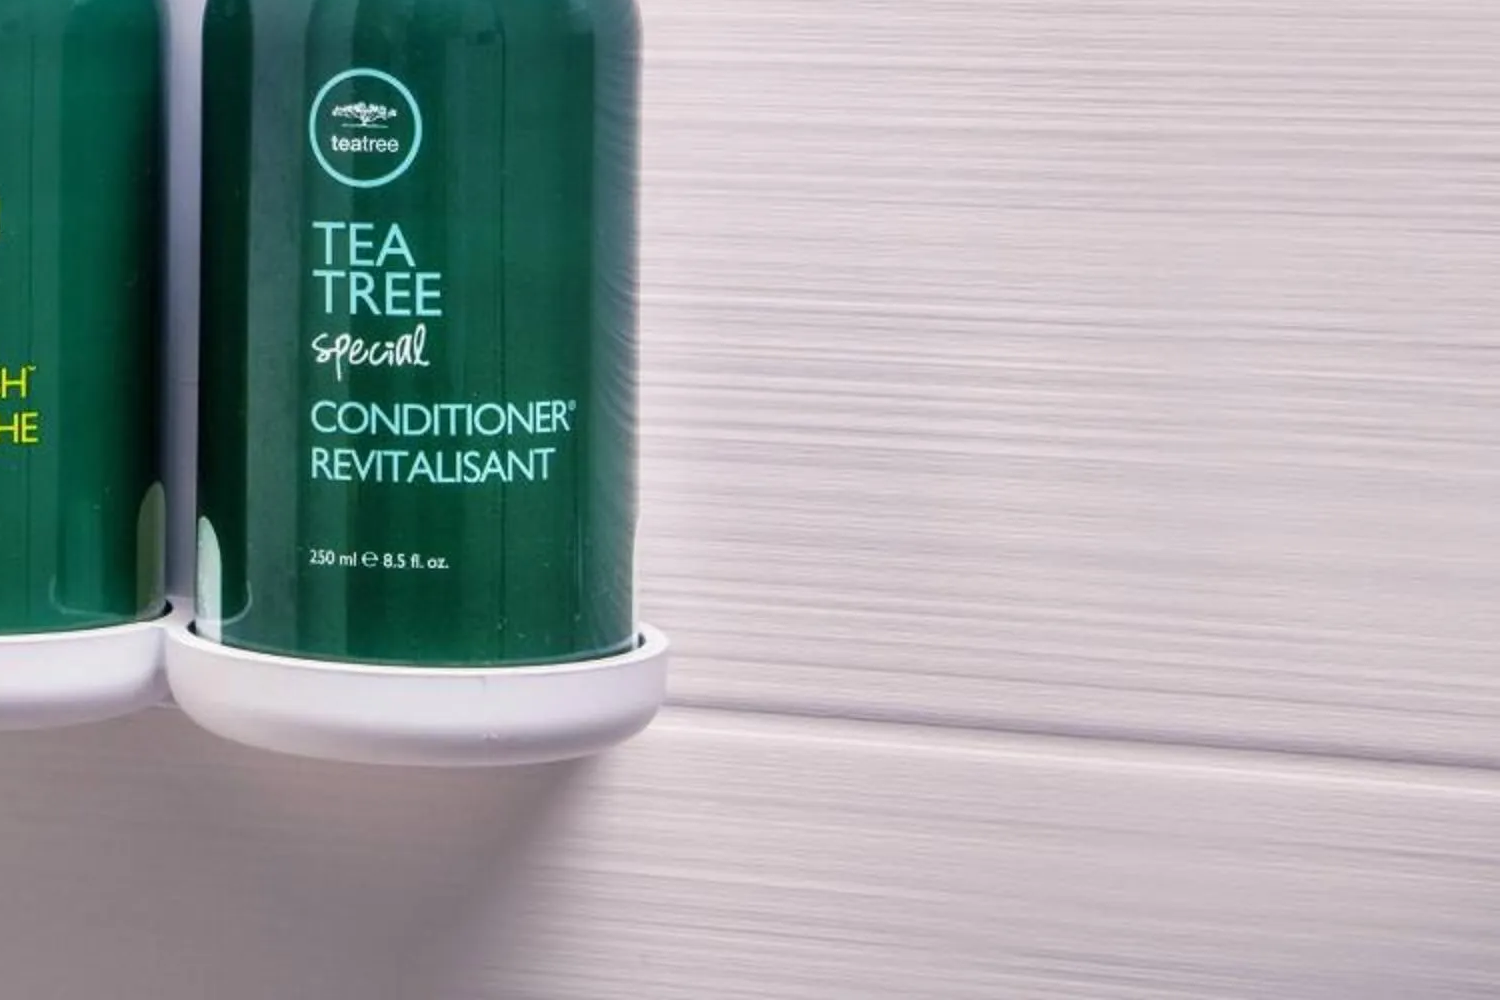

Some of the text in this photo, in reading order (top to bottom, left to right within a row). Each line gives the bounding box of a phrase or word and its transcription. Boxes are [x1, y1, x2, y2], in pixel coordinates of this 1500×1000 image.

[331, 135, 399, 153] teatree
[312, 221, 416, 267] TEA
[312, 269, 442, 316] TREE
[311, 323, 430, 381] special
[311, 447, 556, 483] REVITALISANT
[309, 549, 335, 565] 250
[339, 552, 357, 567] ml
[383, 552, 405, 568] 8.5
[427, 557, 449, 569] oz.
